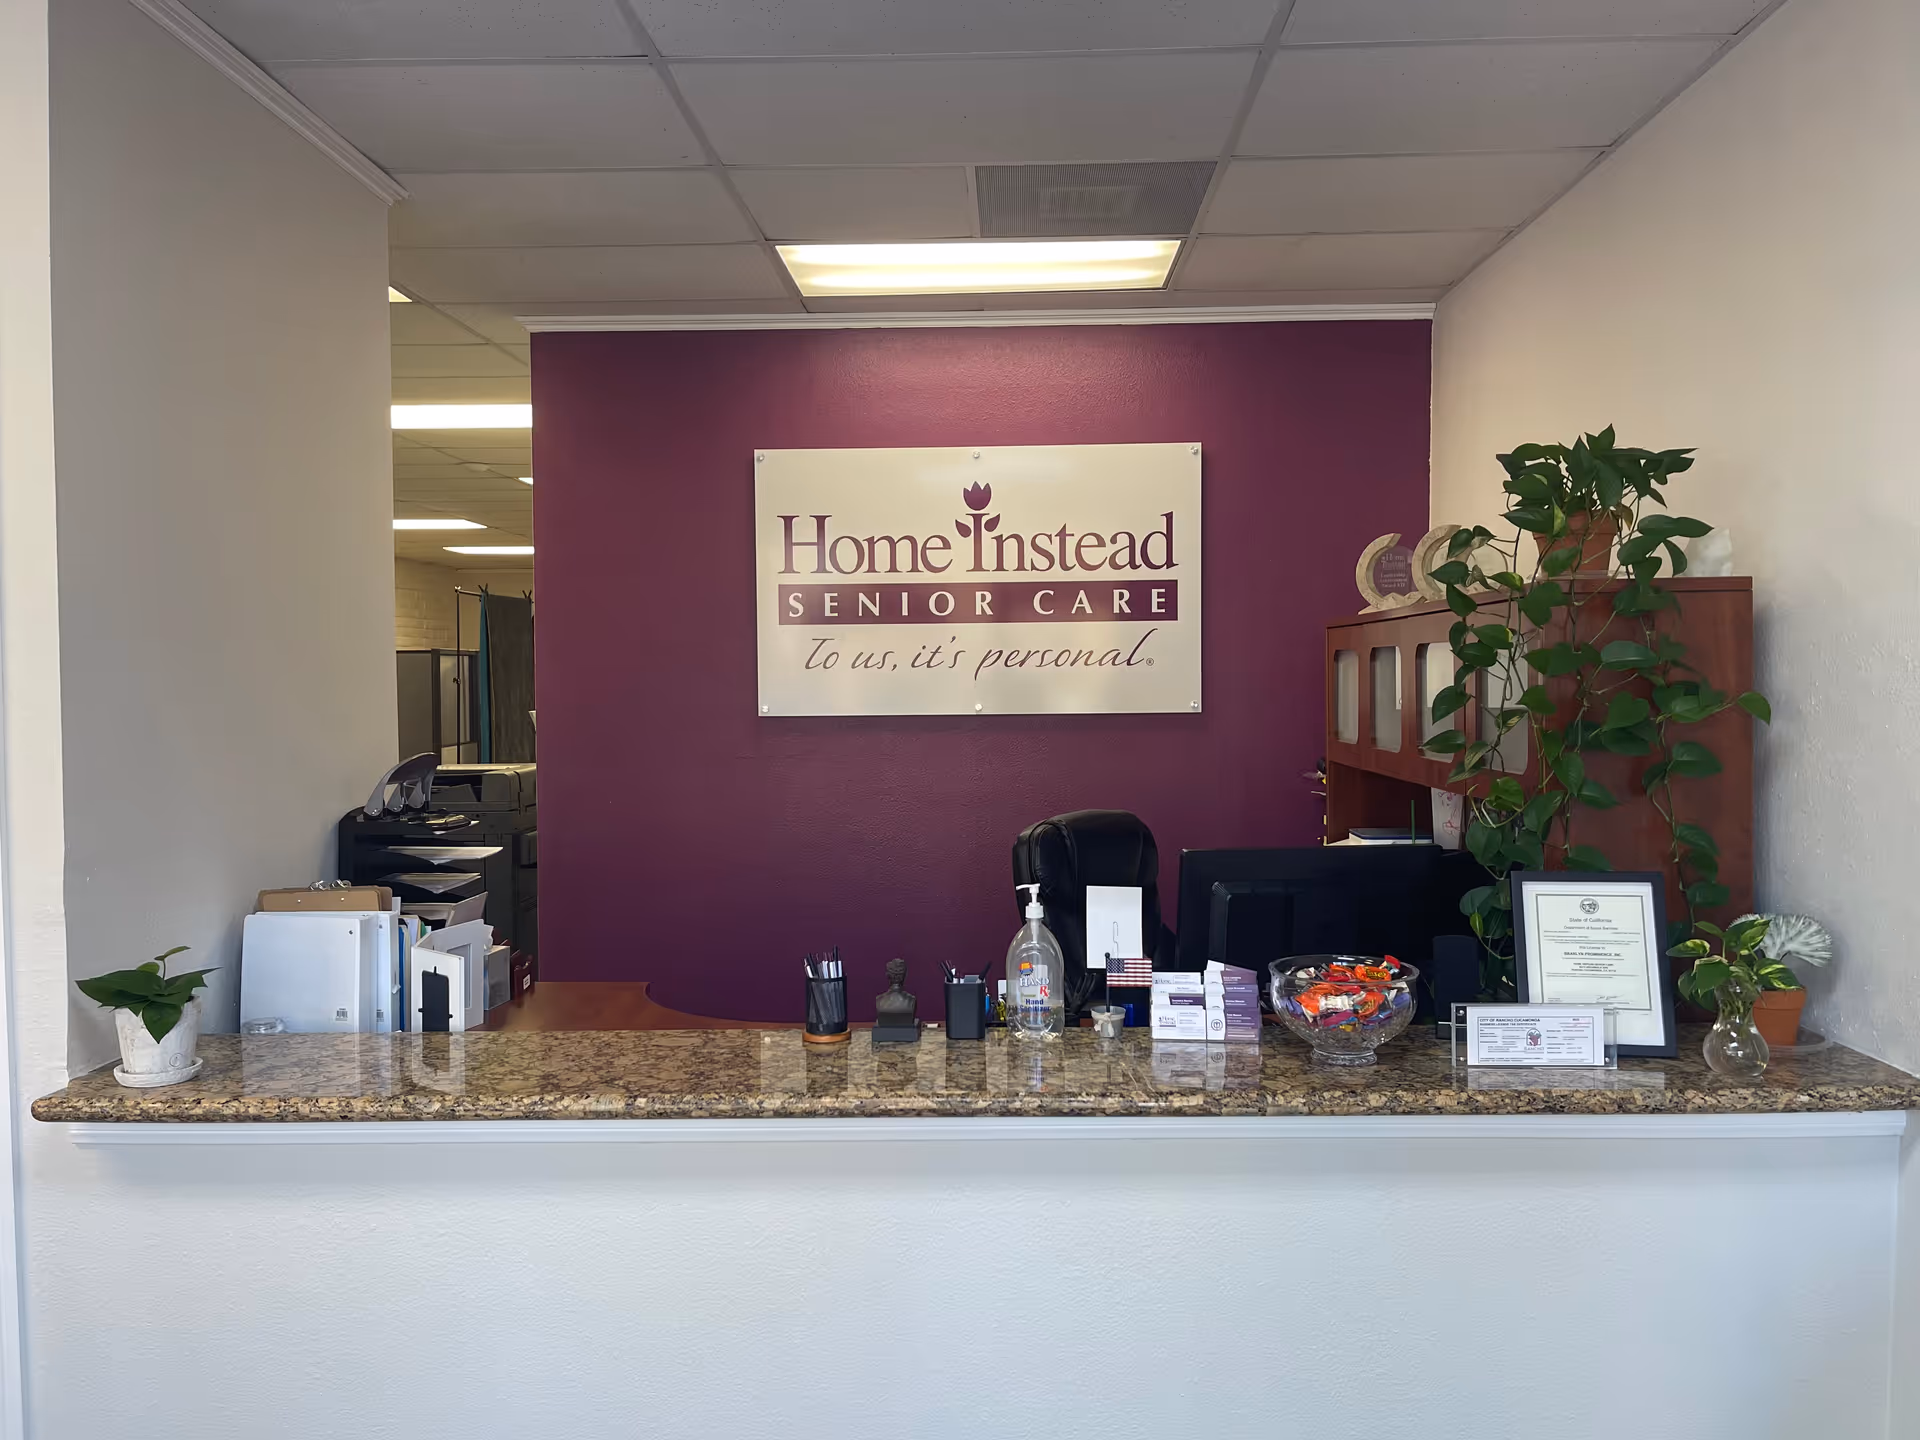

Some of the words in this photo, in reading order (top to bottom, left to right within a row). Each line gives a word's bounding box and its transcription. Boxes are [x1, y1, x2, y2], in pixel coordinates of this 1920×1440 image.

[776, 514, 953, 574] Home
[965, 510, 1179, 573] Instead
[788, 589, 994, 618] SENIOR
[1032, 588, 1167, 615] CARE
[804, 637, 840, 670] To
[850, 648, 898, 672] us,
[910, 635, 966, 669] it's
[1019, 976, 1050, 987] HAND
